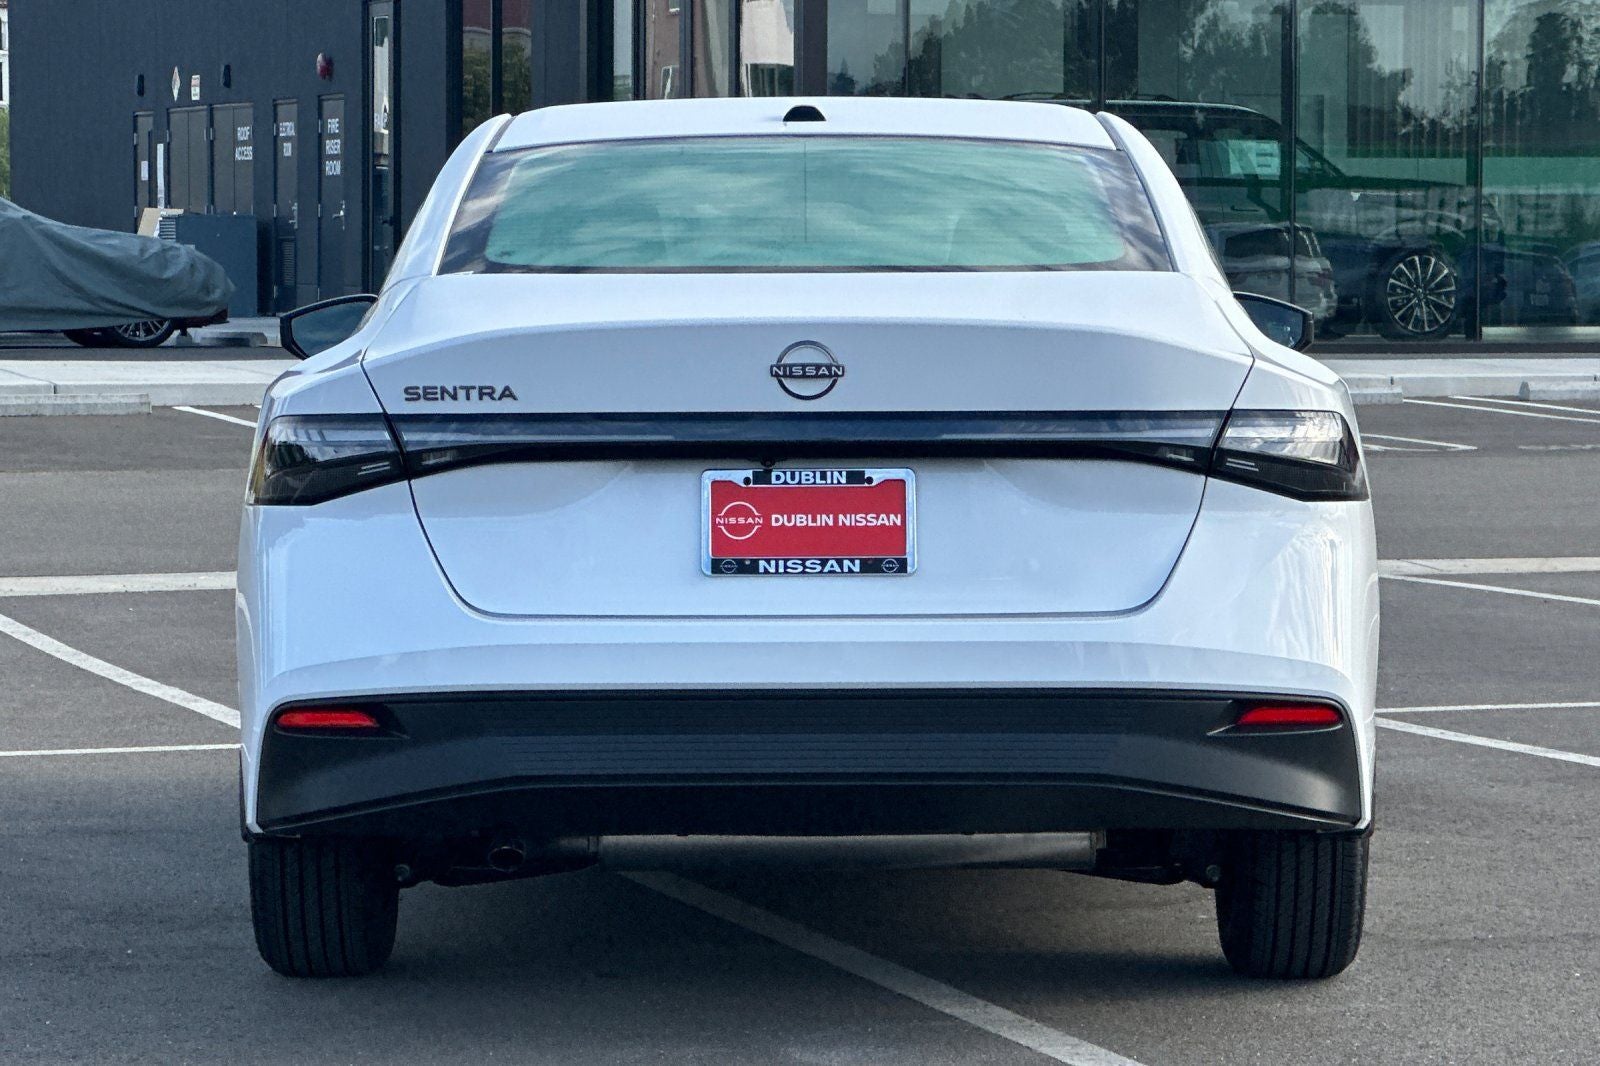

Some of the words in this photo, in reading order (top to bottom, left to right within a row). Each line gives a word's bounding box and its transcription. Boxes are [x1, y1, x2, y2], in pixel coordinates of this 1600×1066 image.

[237, 126, 250, 141] ROOF
[327, 118, 340, 134] FIRE
[235, 146, 253, 161] ACCESS
[325, 160, 341, 176] ROOM
[772, 366, 843, 376] NISSAN
[403, 384, 519, 402] SENTRA
[770, 471, 847, 485] DUBLIN
[715, 516, 763, 525] NISSAN
[771, 513, 834, 527] DUBLIN
[838, 513, 902, 527] NISSAN
[757, 558, 861, 573] NISSAN
